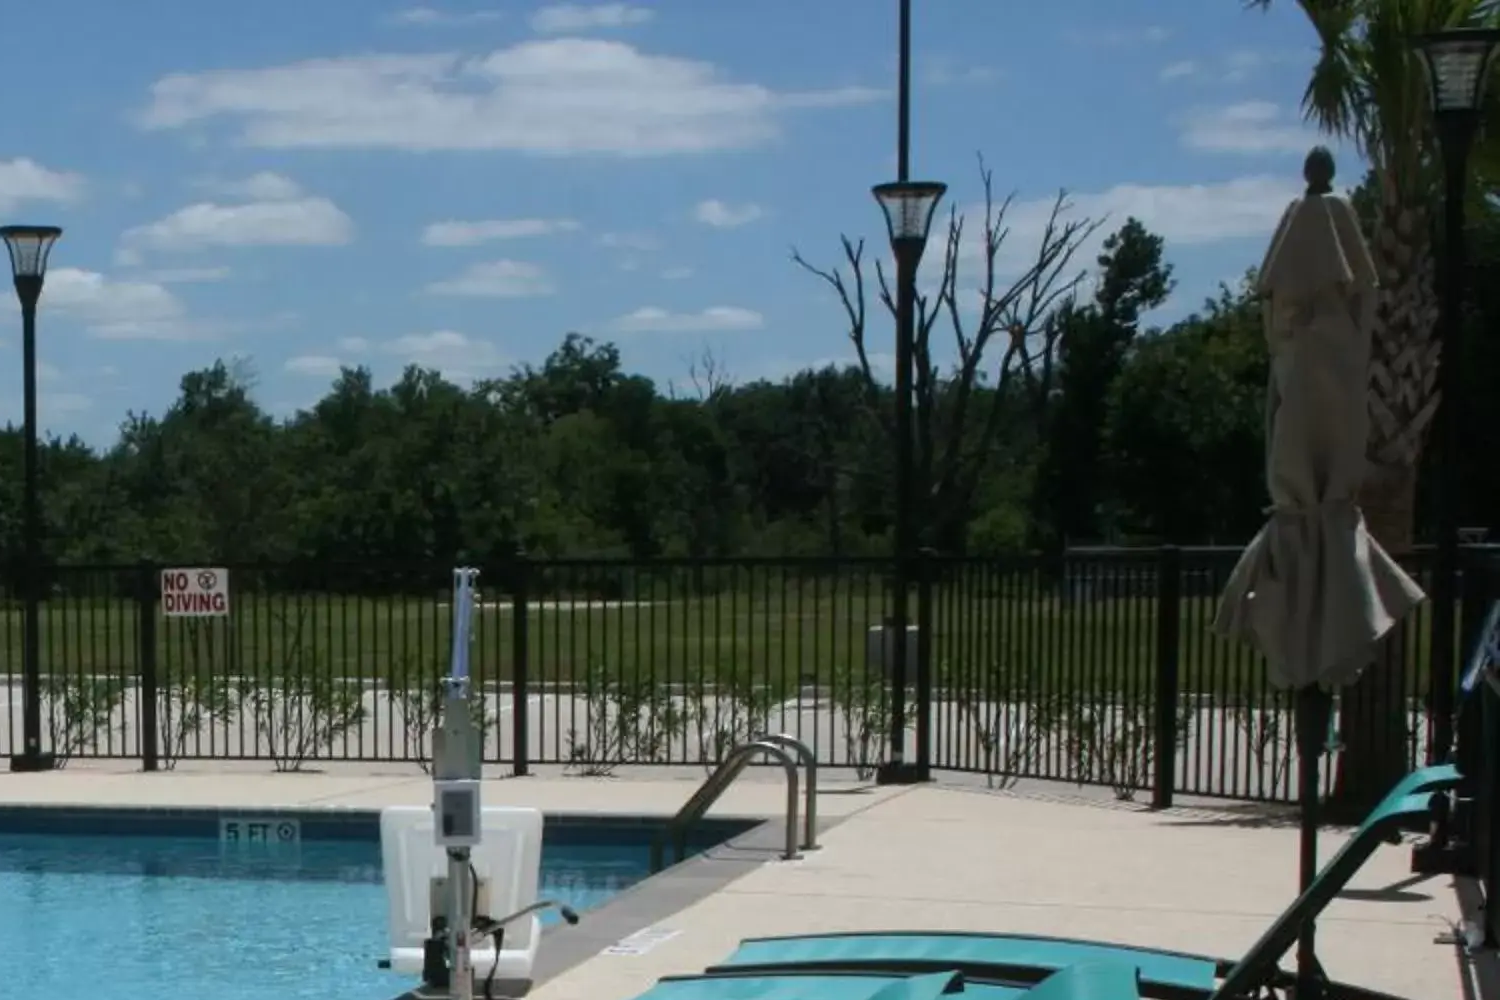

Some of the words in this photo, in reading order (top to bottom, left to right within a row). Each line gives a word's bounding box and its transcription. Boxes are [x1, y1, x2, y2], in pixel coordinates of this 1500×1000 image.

[163, 572, 188, 592] NO
[164, 592, 226, 612] DIVING
[225, 822, 239, 842] 5
[248, 823, 269, 846] FT
